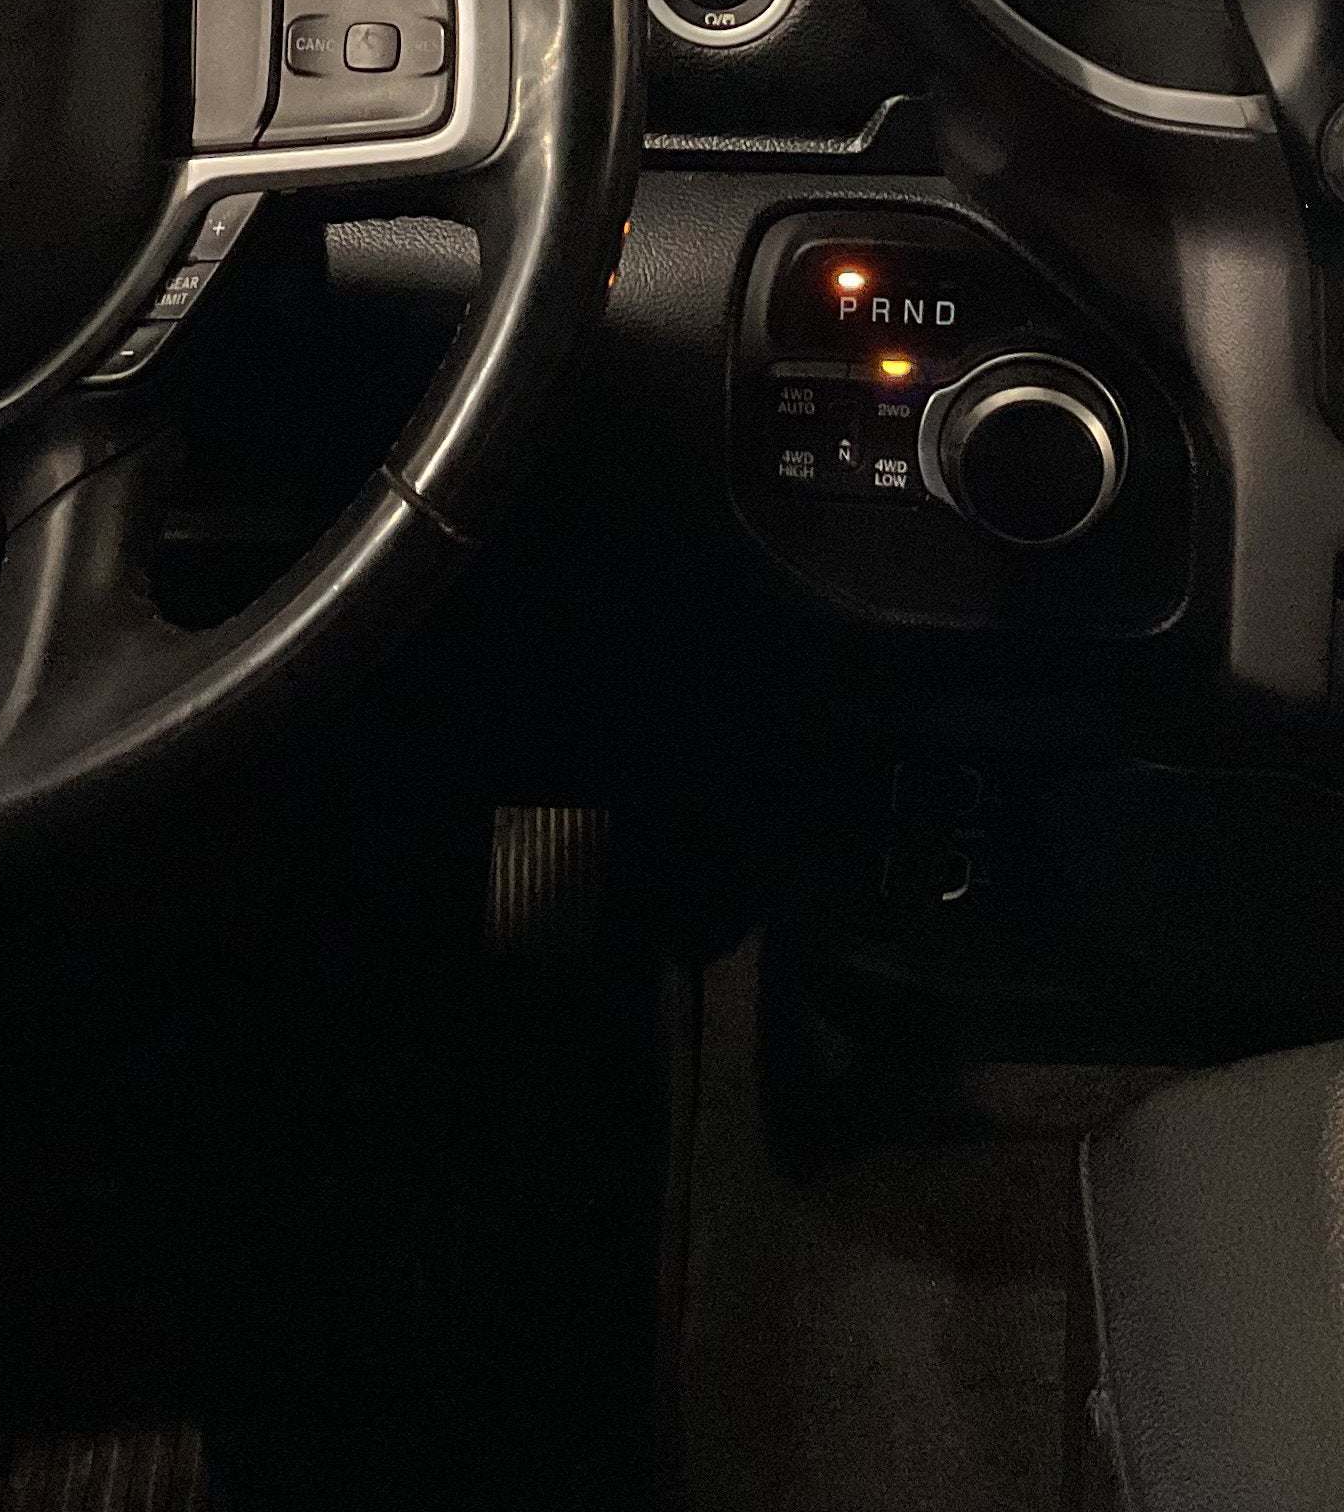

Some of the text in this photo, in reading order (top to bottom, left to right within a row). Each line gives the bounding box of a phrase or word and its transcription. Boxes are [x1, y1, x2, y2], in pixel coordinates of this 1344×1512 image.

[295, 37, 337, 52] CANC
[839, 296, 956, 326] P R N D
[780, 387, 814, 401] 4WD
[778, 401, 816, 415] AUTO
[877, 404, 911, 418] 2WD
[781, 449, 815, 465] 4WD
[838, 448, 851, 462] N
[778, 464, 815, 479] HIGH
[874, 458, 909, 474] 4WD
[874, 473, 908, 488] LOW
